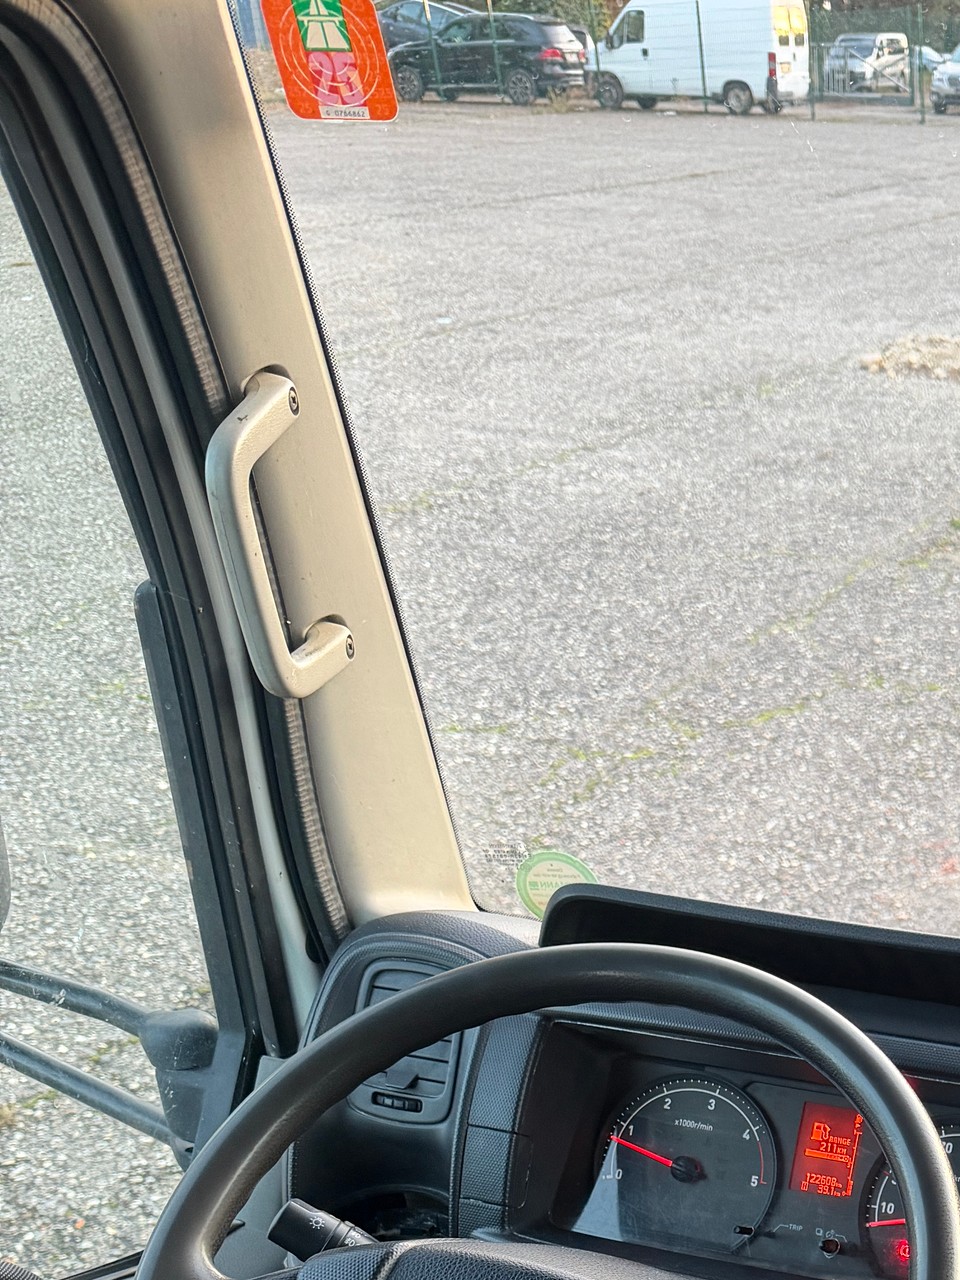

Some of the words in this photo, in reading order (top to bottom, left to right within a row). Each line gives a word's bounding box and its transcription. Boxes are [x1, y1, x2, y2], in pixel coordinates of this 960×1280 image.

[307, 51, 366, 106] 25
[663, 1098, 672, 1110] 2
[707, 1099, 716, 1111] 3
[628, 1124, 634, 1136] 1
[742, 1128, 750, 1141] 4
[829, 1136, 852, 1146] RANGE
[615, 1168, 623, 1180] 0
[750, 1175, 759, 1187] 5
[880, 1201, 895, 1215] 10
[788, 1223, 803, 1232] TRIP
